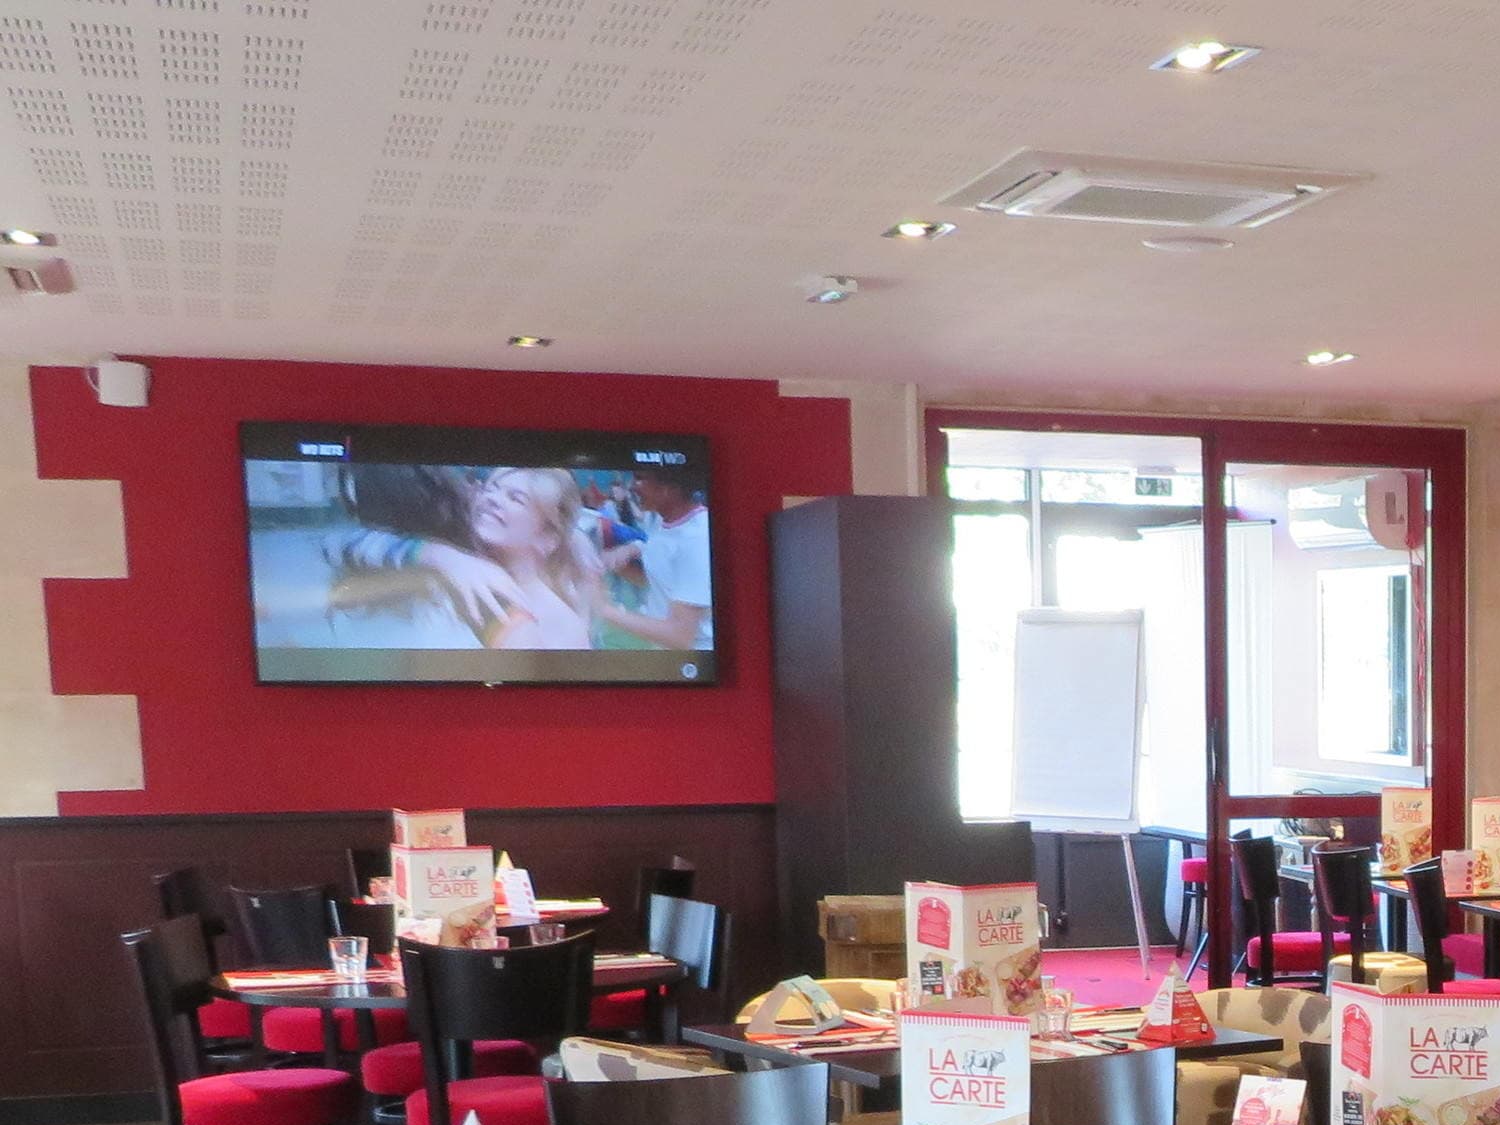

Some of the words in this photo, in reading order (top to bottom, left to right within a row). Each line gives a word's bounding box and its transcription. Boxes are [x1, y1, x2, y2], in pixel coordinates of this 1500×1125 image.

[426, 866, 447, 880] LA
[428, 882, 478, 896] CARTE
[977, 908, 994, 924] LA
[978, 925, 1024, 943] CARTE
[1410, 1026, 1439, 1048] LA
[929, 1048, 959, 1071] LA
[1410, 1054, 1488, 1077] CARTE
[929, 1077, 1005, 1104] CARTE
